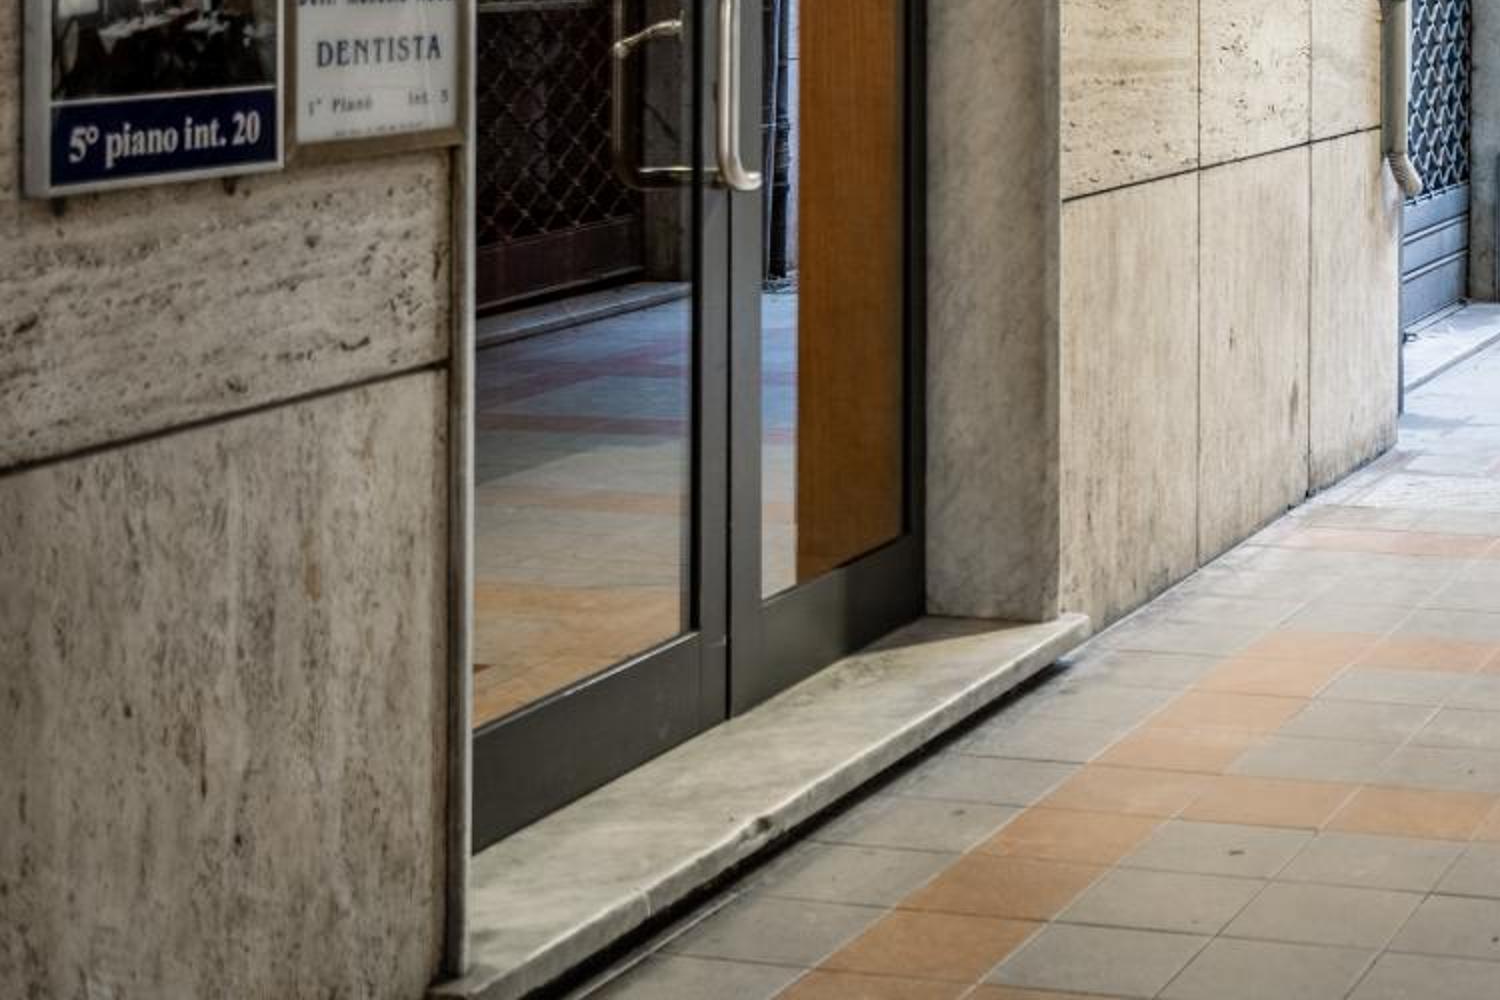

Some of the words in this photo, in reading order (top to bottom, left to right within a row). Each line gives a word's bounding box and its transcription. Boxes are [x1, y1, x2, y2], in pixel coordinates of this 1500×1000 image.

[317, 34, 442, 68] DENTISTA
[105, 121, 179, 169] piano
[183, 116, 226, 150] int.
[232, 110, 261, 146] 20
